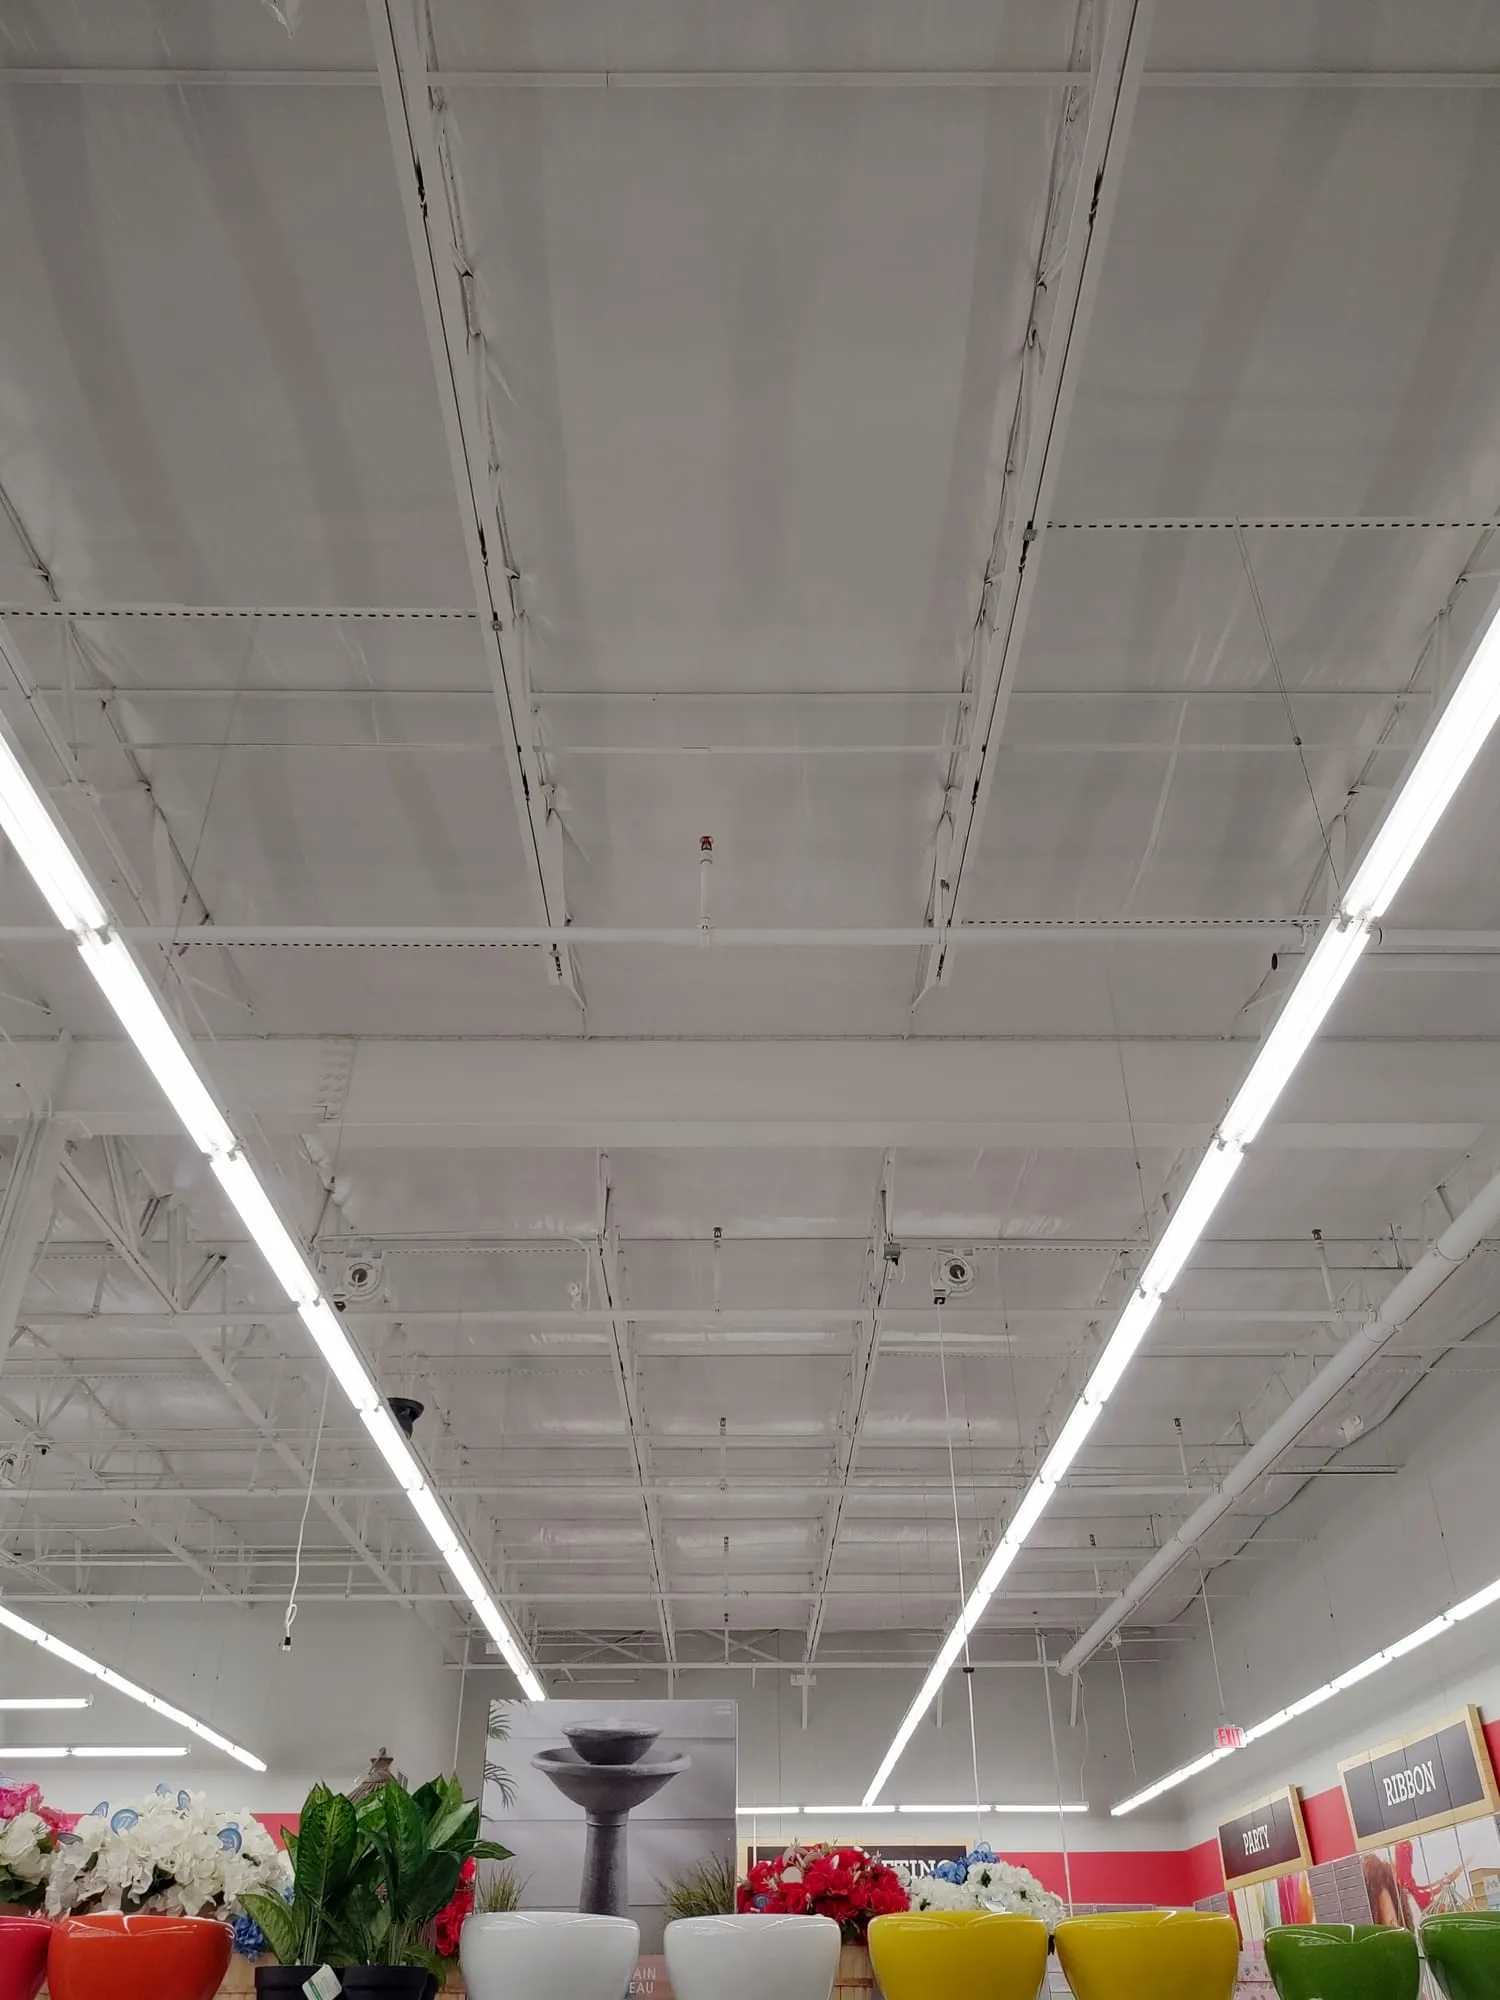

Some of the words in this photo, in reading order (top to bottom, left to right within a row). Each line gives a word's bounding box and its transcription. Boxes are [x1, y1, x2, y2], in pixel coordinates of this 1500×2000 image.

[1217, 1727, 1241, 1747] EXIT
[1382, 1760, 1437, 1807] RIBBON
[1242, 1824, 1270, 1856] PARTY
[632, 1967, 656, 1980] AIN
